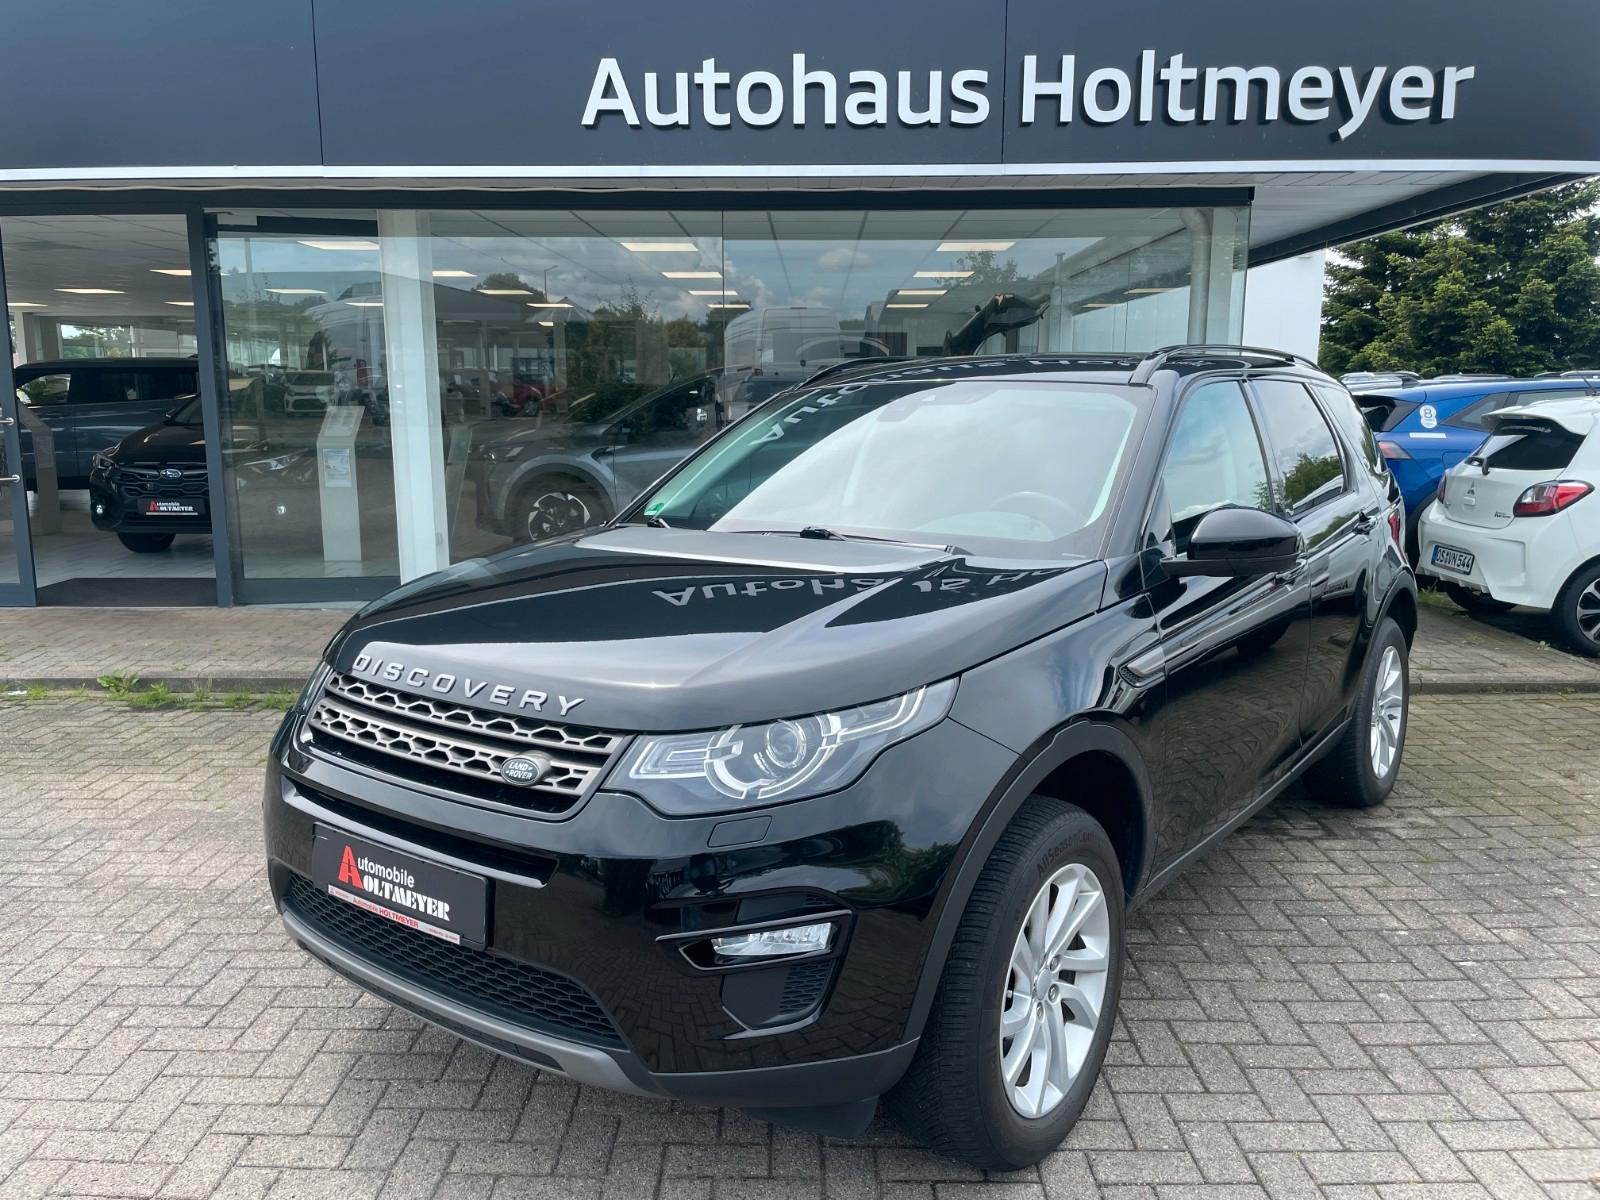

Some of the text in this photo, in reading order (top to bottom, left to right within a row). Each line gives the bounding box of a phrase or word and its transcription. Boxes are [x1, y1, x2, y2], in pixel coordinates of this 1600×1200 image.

[581, 50, 1475, 139] Autohaus Holtmeyer
[1424, 409, 1433, 418] 8
[352, 654, 585, 716] DISCOVERY
[509, 762, 528, 771] LAND
[509, 769, 532, 780] ROVER
[379, 908, 418, 928] HOLTMEYER
